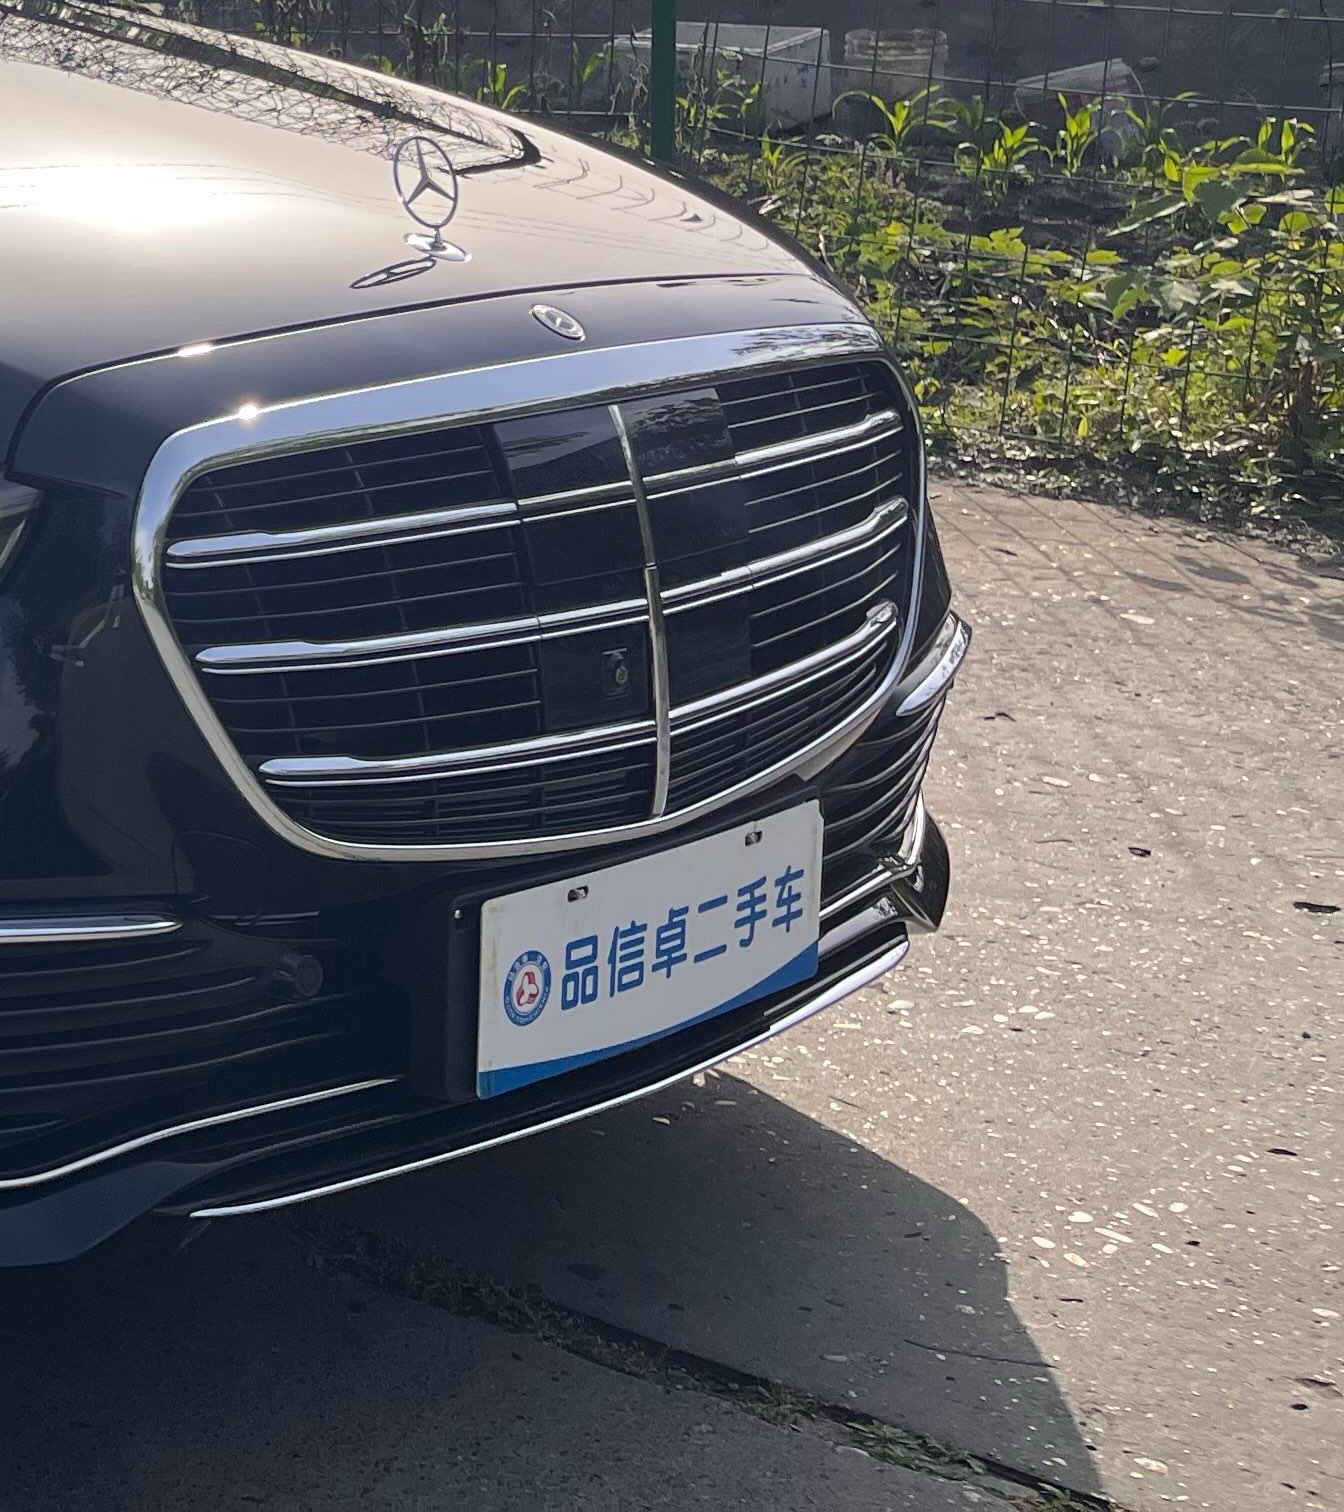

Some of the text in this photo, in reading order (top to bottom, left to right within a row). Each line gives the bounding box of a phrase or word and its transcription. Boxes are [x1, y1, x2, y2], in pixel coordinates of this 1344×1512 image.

[561, 865, 804, 1010] 品信卓二手车
